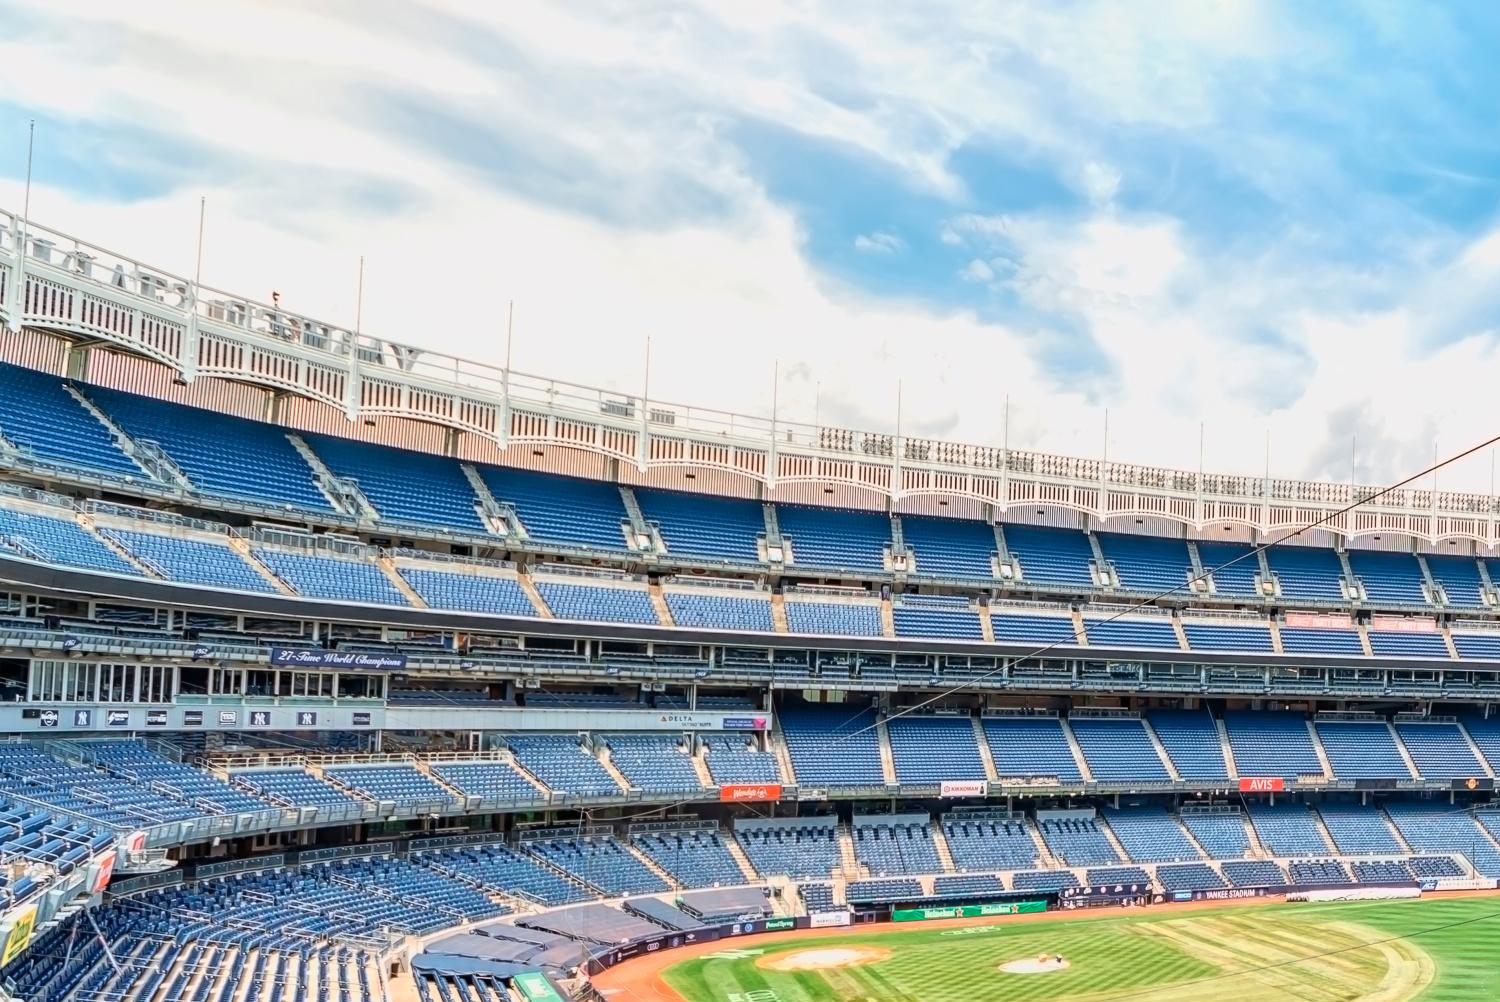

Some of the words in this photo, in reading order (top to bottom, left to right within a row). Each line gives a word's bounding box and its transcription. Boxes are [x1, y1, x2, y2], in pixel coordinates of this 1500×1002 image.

[323, 652, 355, 665] World
[355, 654, 402, 668] Champions
[1250, 779, 1273, 790] AVIS
[1174, 892, 1192, 900] GEICO
[1205, 890, 1229, 900] YANKEE
[1229, 888, 1256, 899] STADIUM
